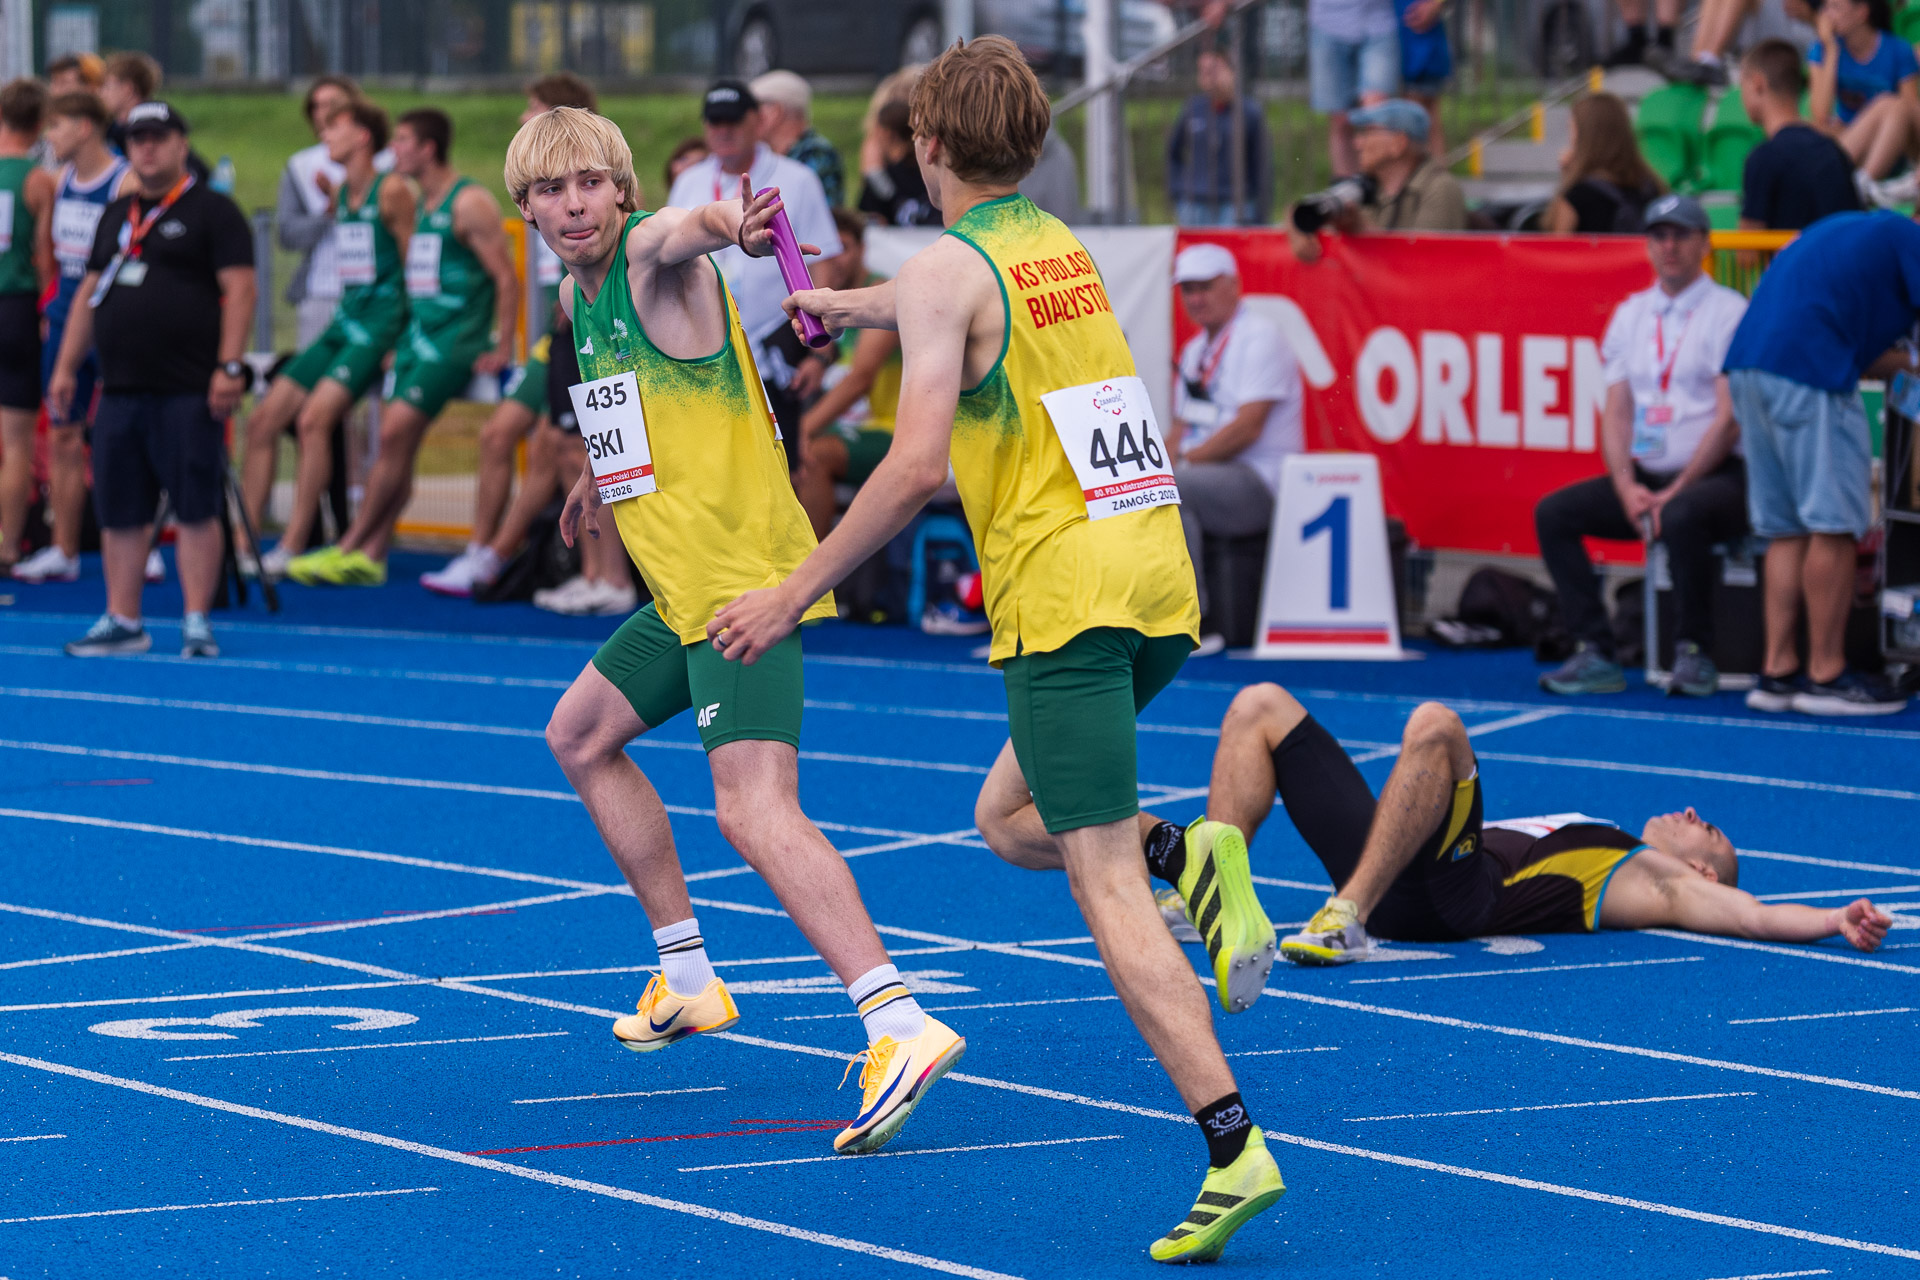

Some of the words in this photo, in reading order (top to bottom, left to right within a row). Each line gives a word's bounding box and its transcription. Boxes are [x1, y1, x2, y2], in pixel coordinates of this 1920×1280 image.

[1008, 262, 1040, 290] KS
[1026, 282, 1113, 329] BIAŁYSTO
[585, 382, 627, 411] 435
[1090, 419, 1163, 477] 446
[630, 468, 643, 478] U20
[611, 484, 633, 498] 2026
[1094, 489, 1105, 498] 80.
[1106, 485, 1121, 496] PZLA
[1121, 478, 1159, 493] Mistrzostwa
[1111, 490, 1157, 511] ZAMOŚĆ
[1302, 496, 1349, 610] 1
[87, 1006, 420, 1041] 3
